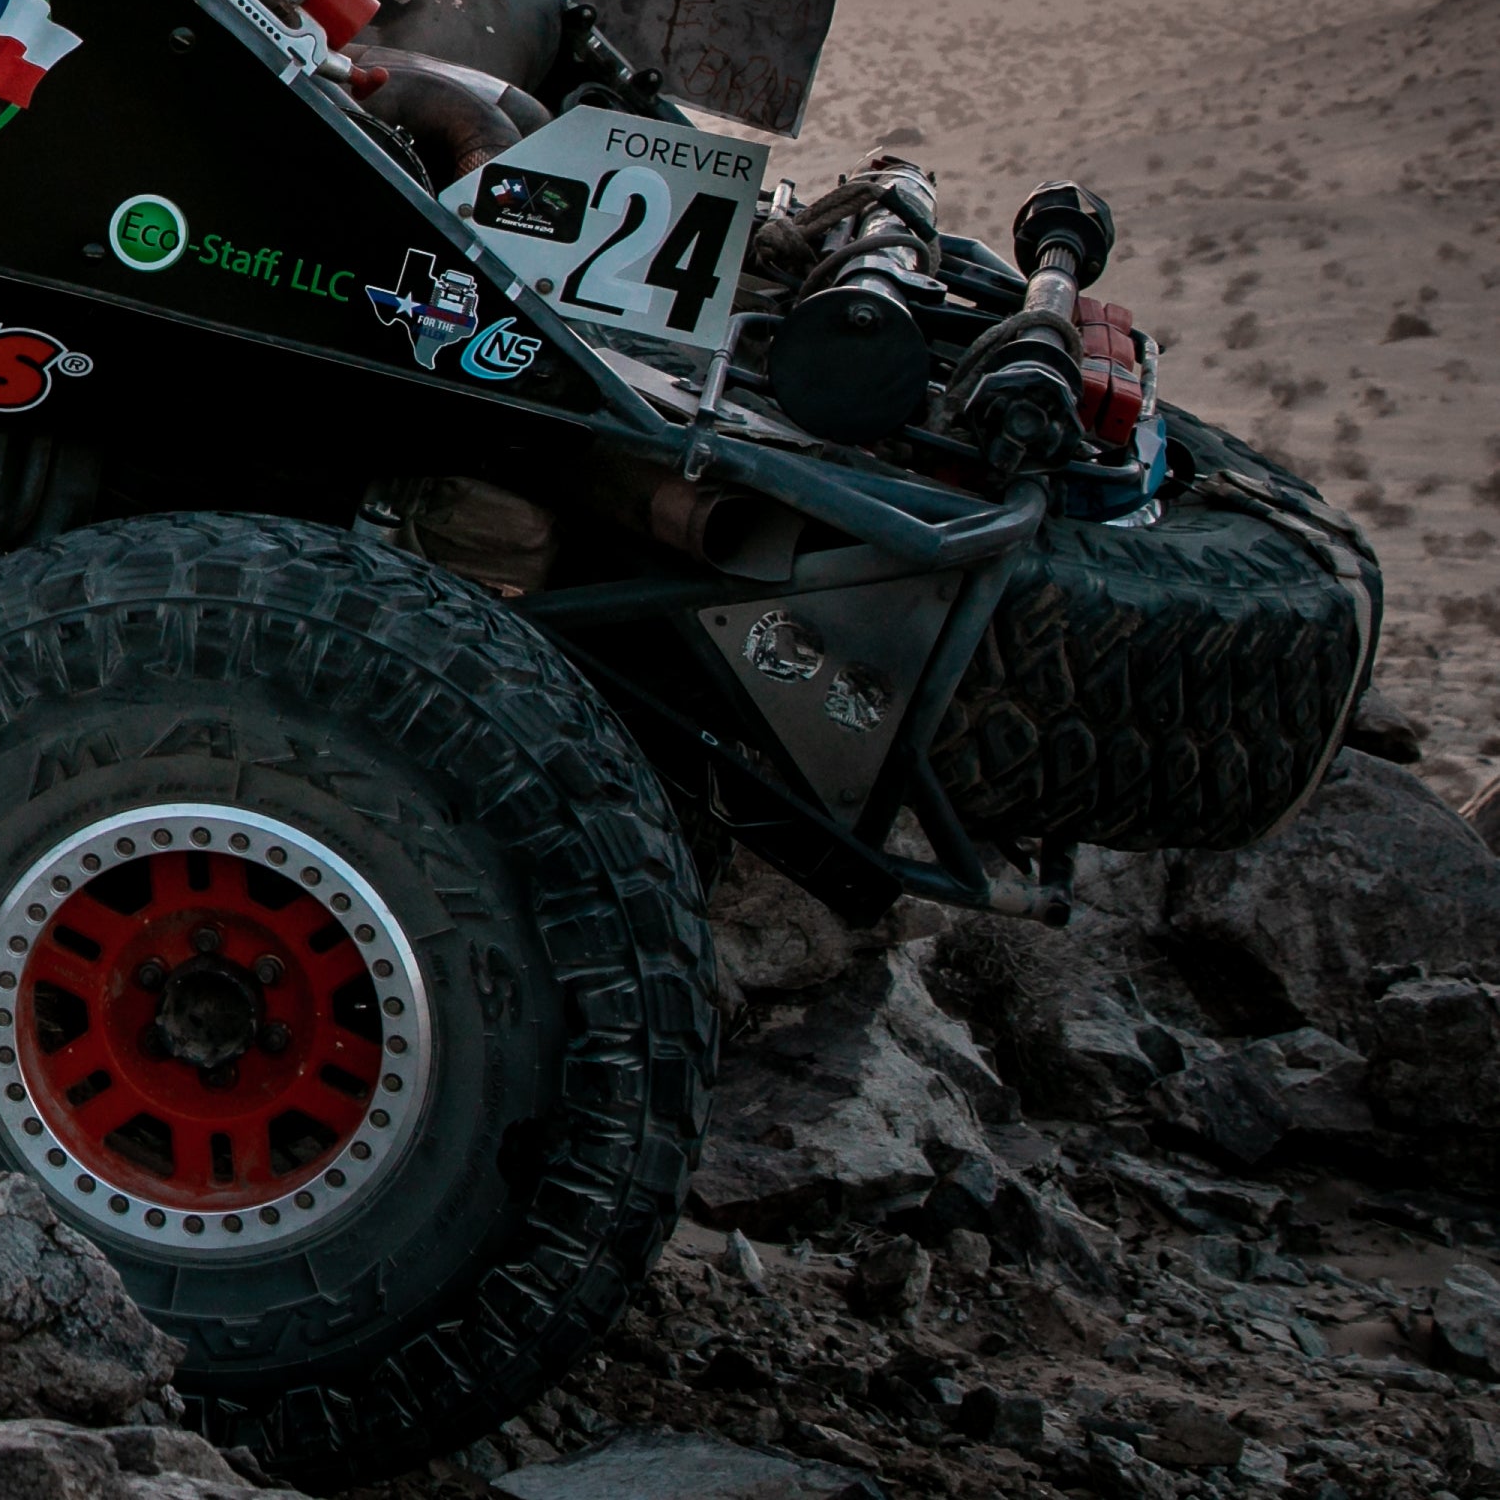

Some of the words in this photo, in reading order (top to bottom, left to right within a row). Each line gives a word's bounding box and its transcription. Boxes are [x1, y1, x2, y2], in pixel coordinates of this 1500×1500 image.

[605, 127, 754, 183] FOREVER
[559, 165, 740, 334] 24
[290, 258, 356, 303] LLC
[417, 314, 436, 329] FOR
[437, 318, 457, 334] THE
[27, 715, 522, 1032] MAXXIS
